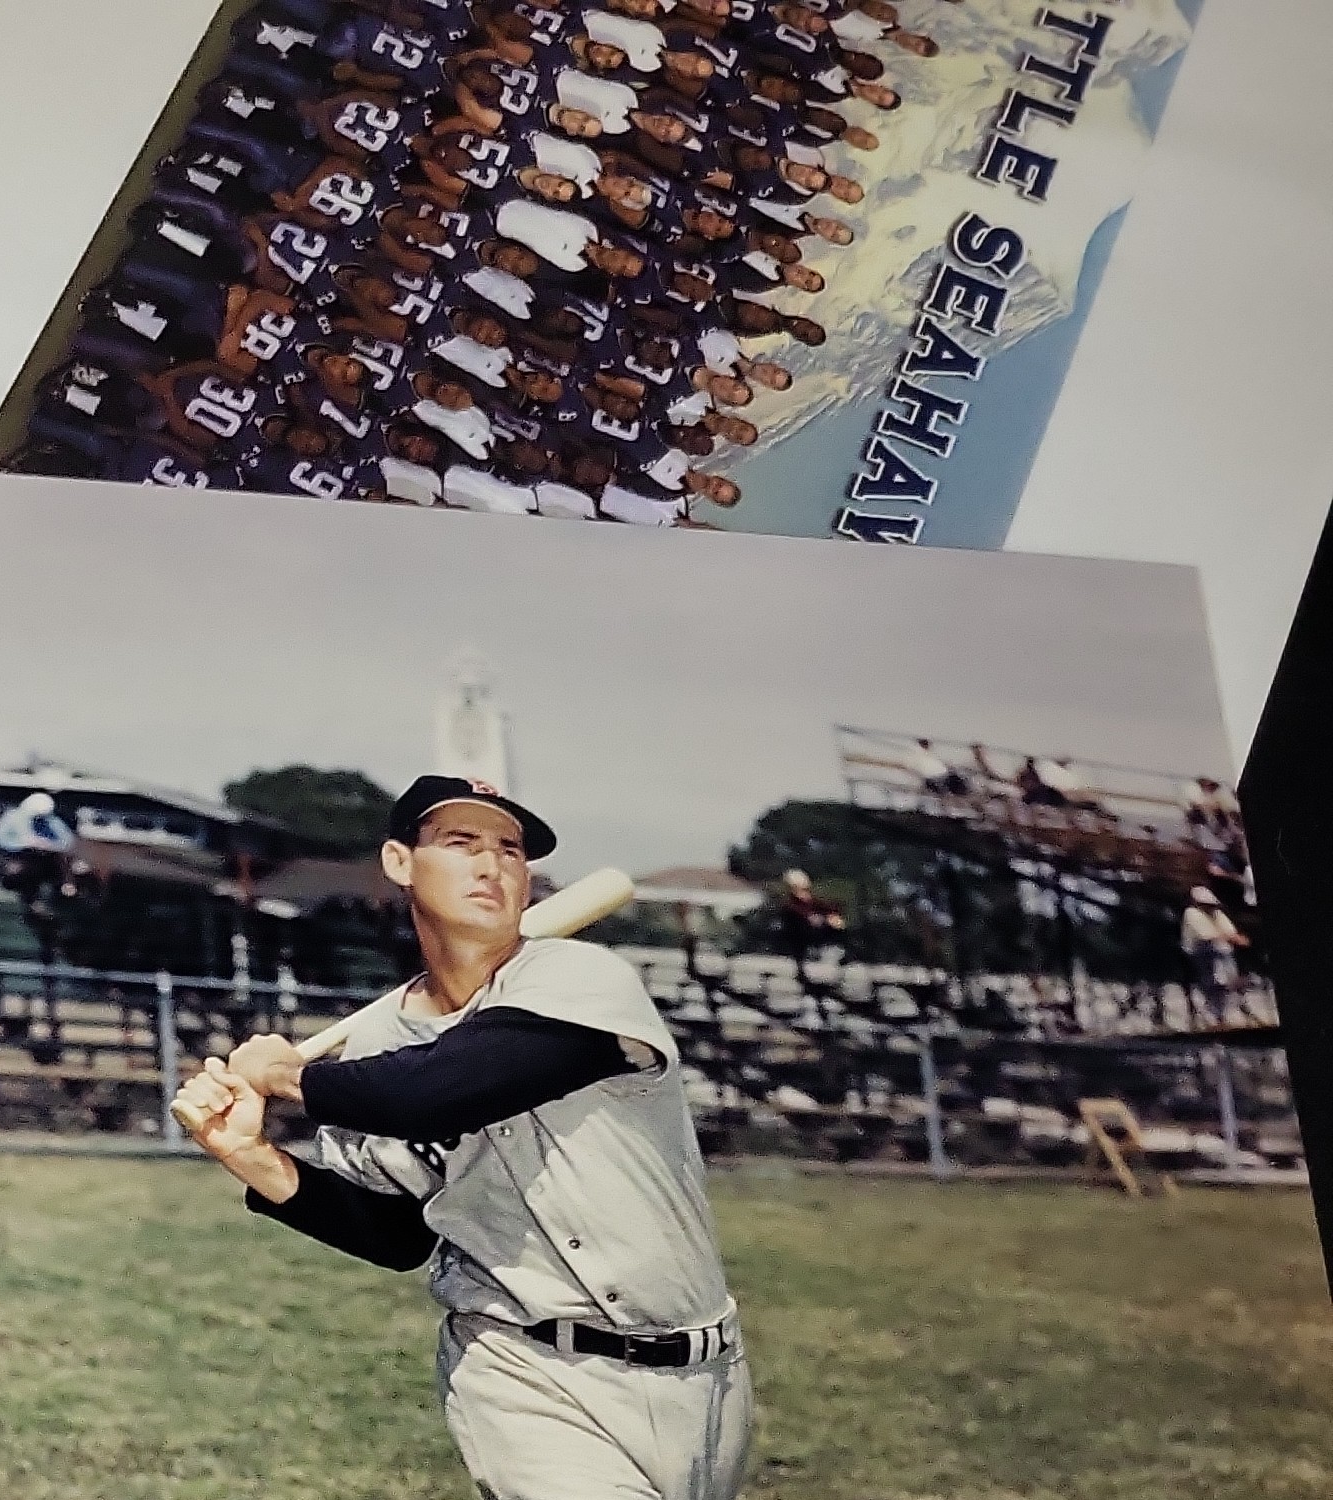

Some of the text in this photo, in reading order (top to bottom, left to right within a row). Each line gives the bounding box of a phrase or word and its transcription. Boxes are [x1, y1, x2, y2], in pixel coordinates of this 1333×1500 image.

[334, 101, 400, 152] 23
[268, 222, 327, 285] 27
[185, 376, 256, 438] 30
